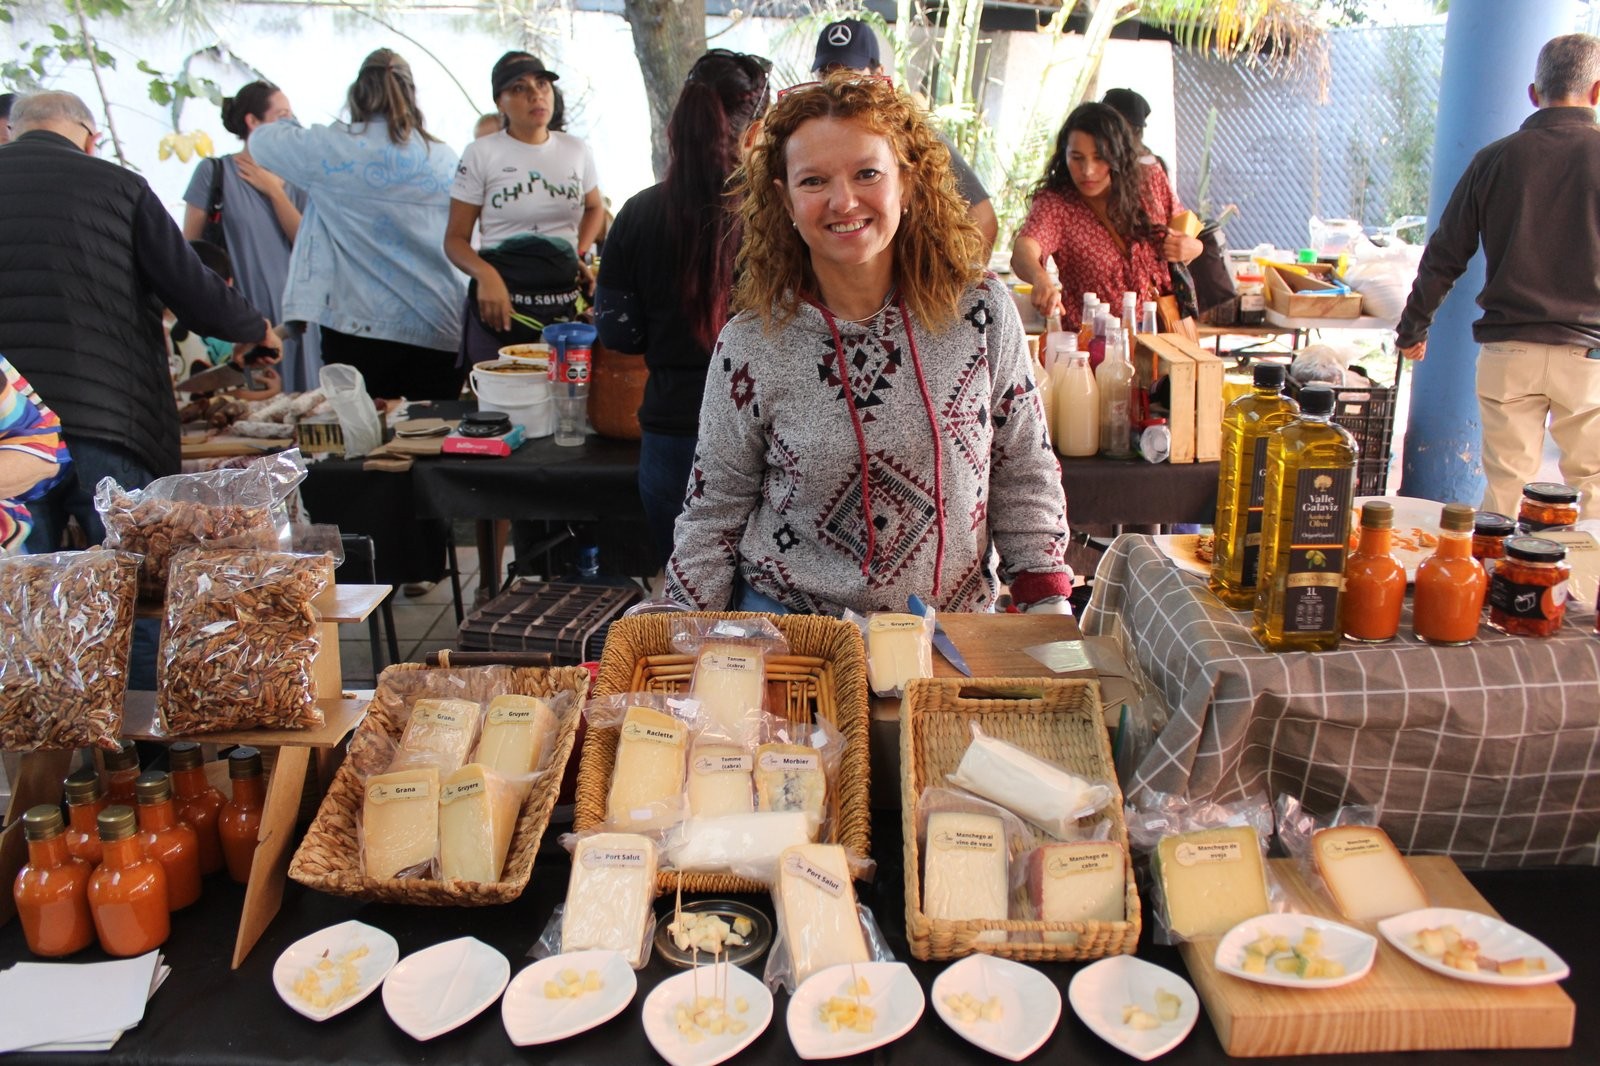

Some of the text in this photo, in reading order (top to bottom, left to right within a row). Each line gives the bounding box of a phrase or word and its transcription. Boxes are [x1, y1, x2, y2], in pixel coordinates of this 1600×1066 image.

[1309, 495, 1335, 503] Valle
[1302, 503, 1339, 512] Galaviz
[1306, 587, 1318, 596] 1L
[437, 713, 456, 722] Grana
[646, 729, 674, 740] Raclette
[395, 785, 416, 794] Grana
[457, 782, 479, 793] Gruyere
[956, 832, 986, 841] Manchego
[605, 853, 621, 861] Port
[622, 853, 641, 861] Salut
[1069, 854, 1098, 863] Manchego
[806, 867, 839, 890] Port Salut
